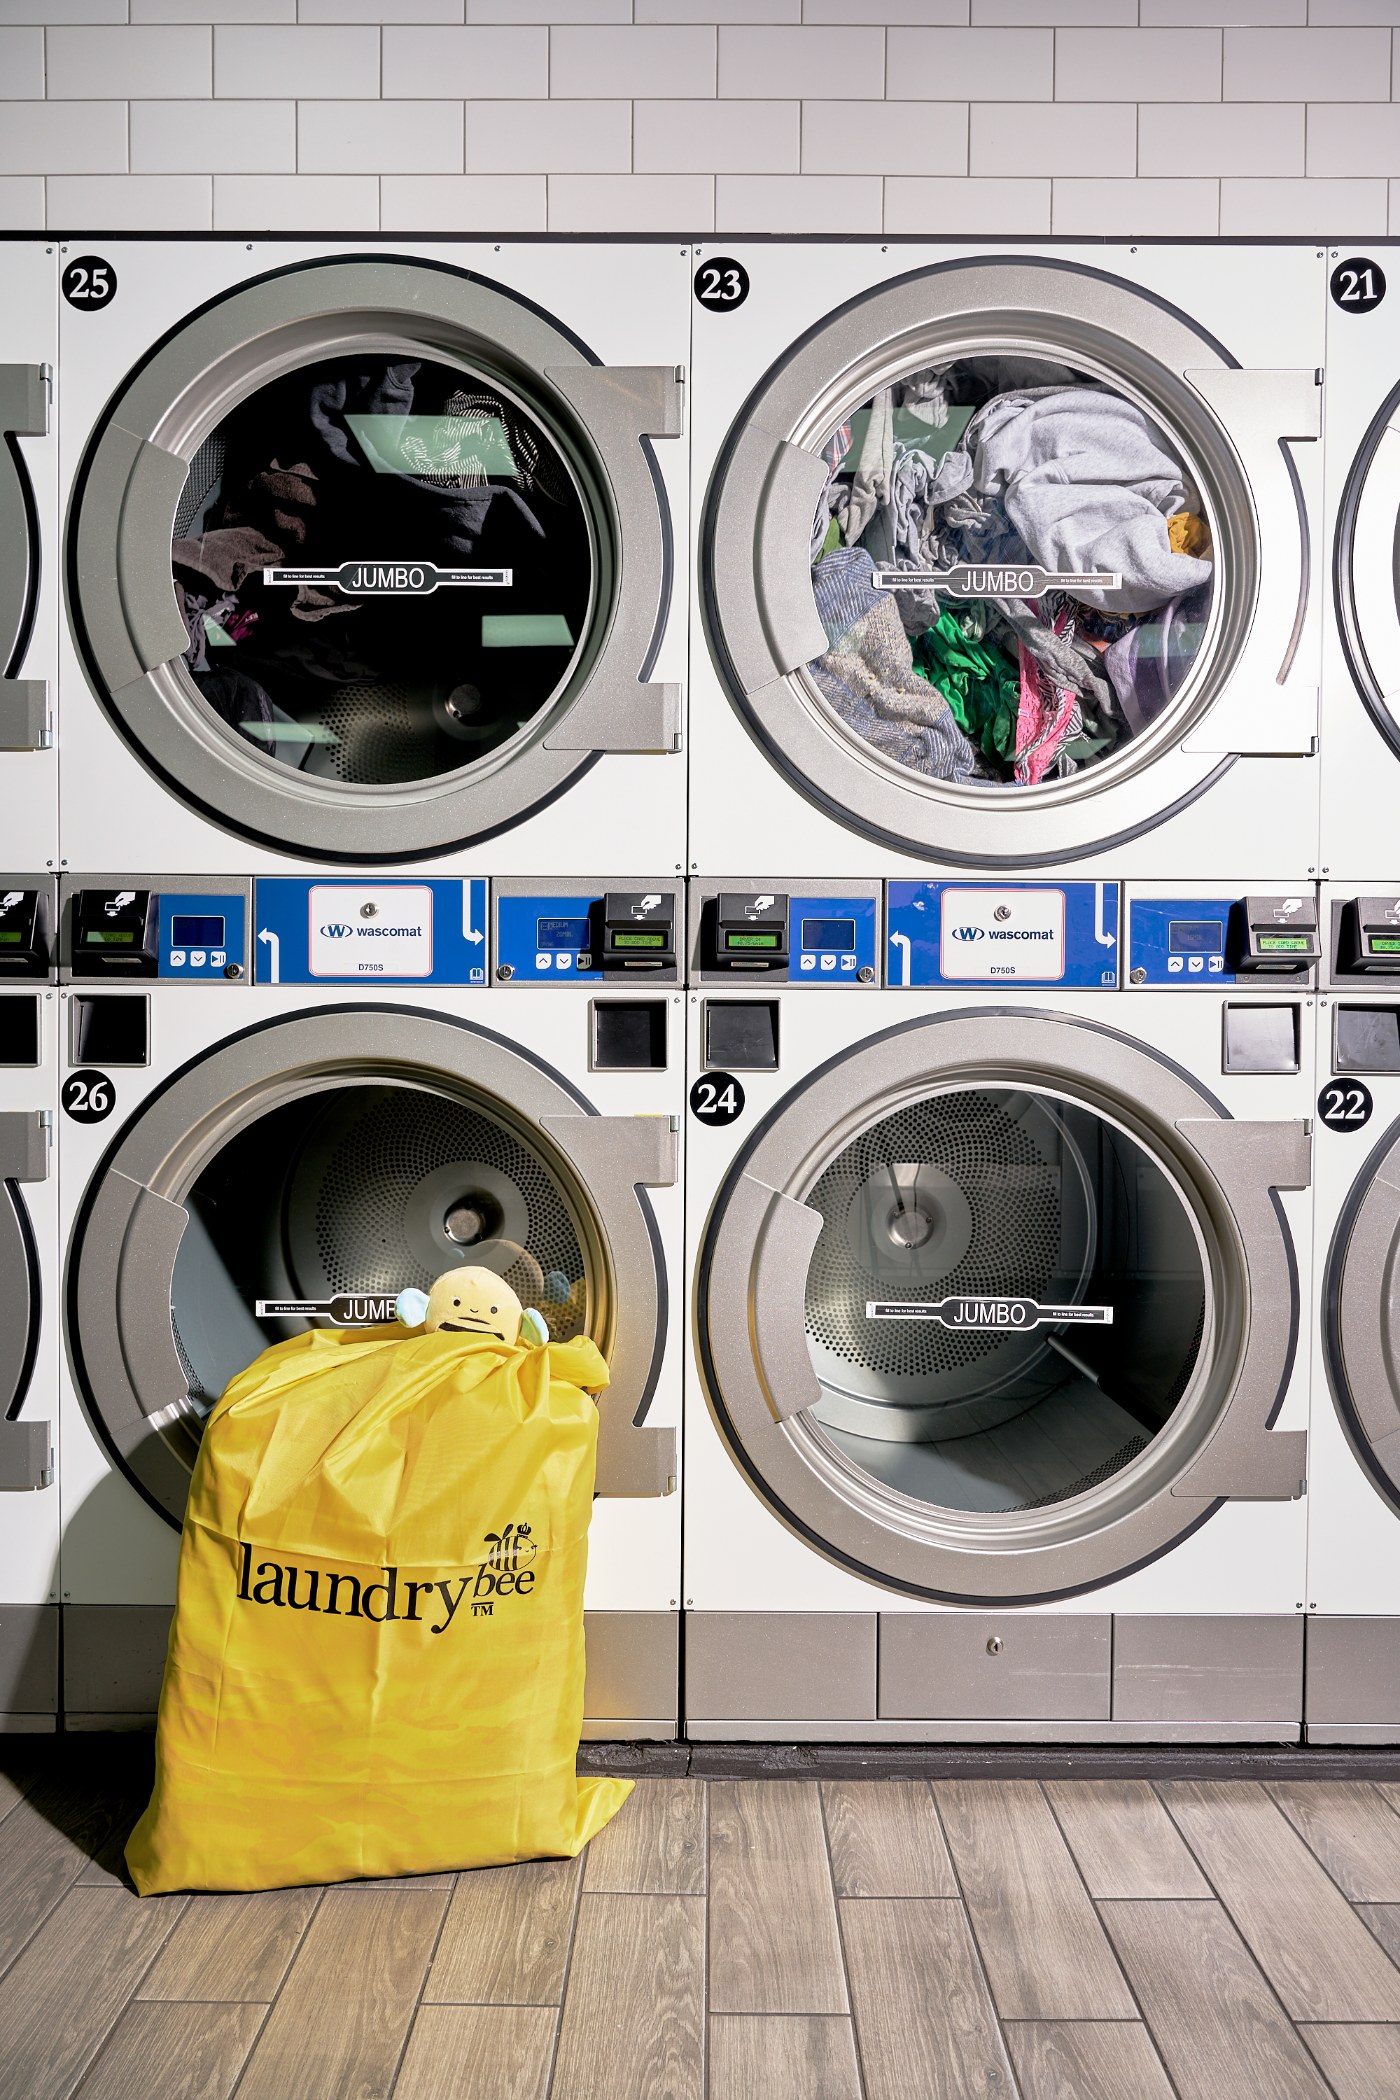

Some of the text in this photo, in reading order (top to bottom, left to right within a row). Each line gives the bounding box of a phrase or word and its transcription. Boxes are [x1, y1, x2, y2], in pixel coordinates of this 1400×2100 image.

[70, 269, 108, 298] 25
[701, 269, 741, 299] 23
[1340, 269, 1377, 300] 21
[352, 568, 424, 588] JUMBO
[961, 570, 1033, 592] JUMBO
[357, 926, 422, 936] wascomat
[989, 930, 1054, 940] wascomat
[69, 1082, 107, 1111] 26
[697, 1084, 737, 1113] 24
[1325, 1090, 1365, 1119] 22
[344, 1300, 395, 1319] JUMB
[954, 1303, 1025, 1324] JUMBO
[236, 1541, 535, 1634] laundry bee
[471, 1605, 494, 1617] TM
